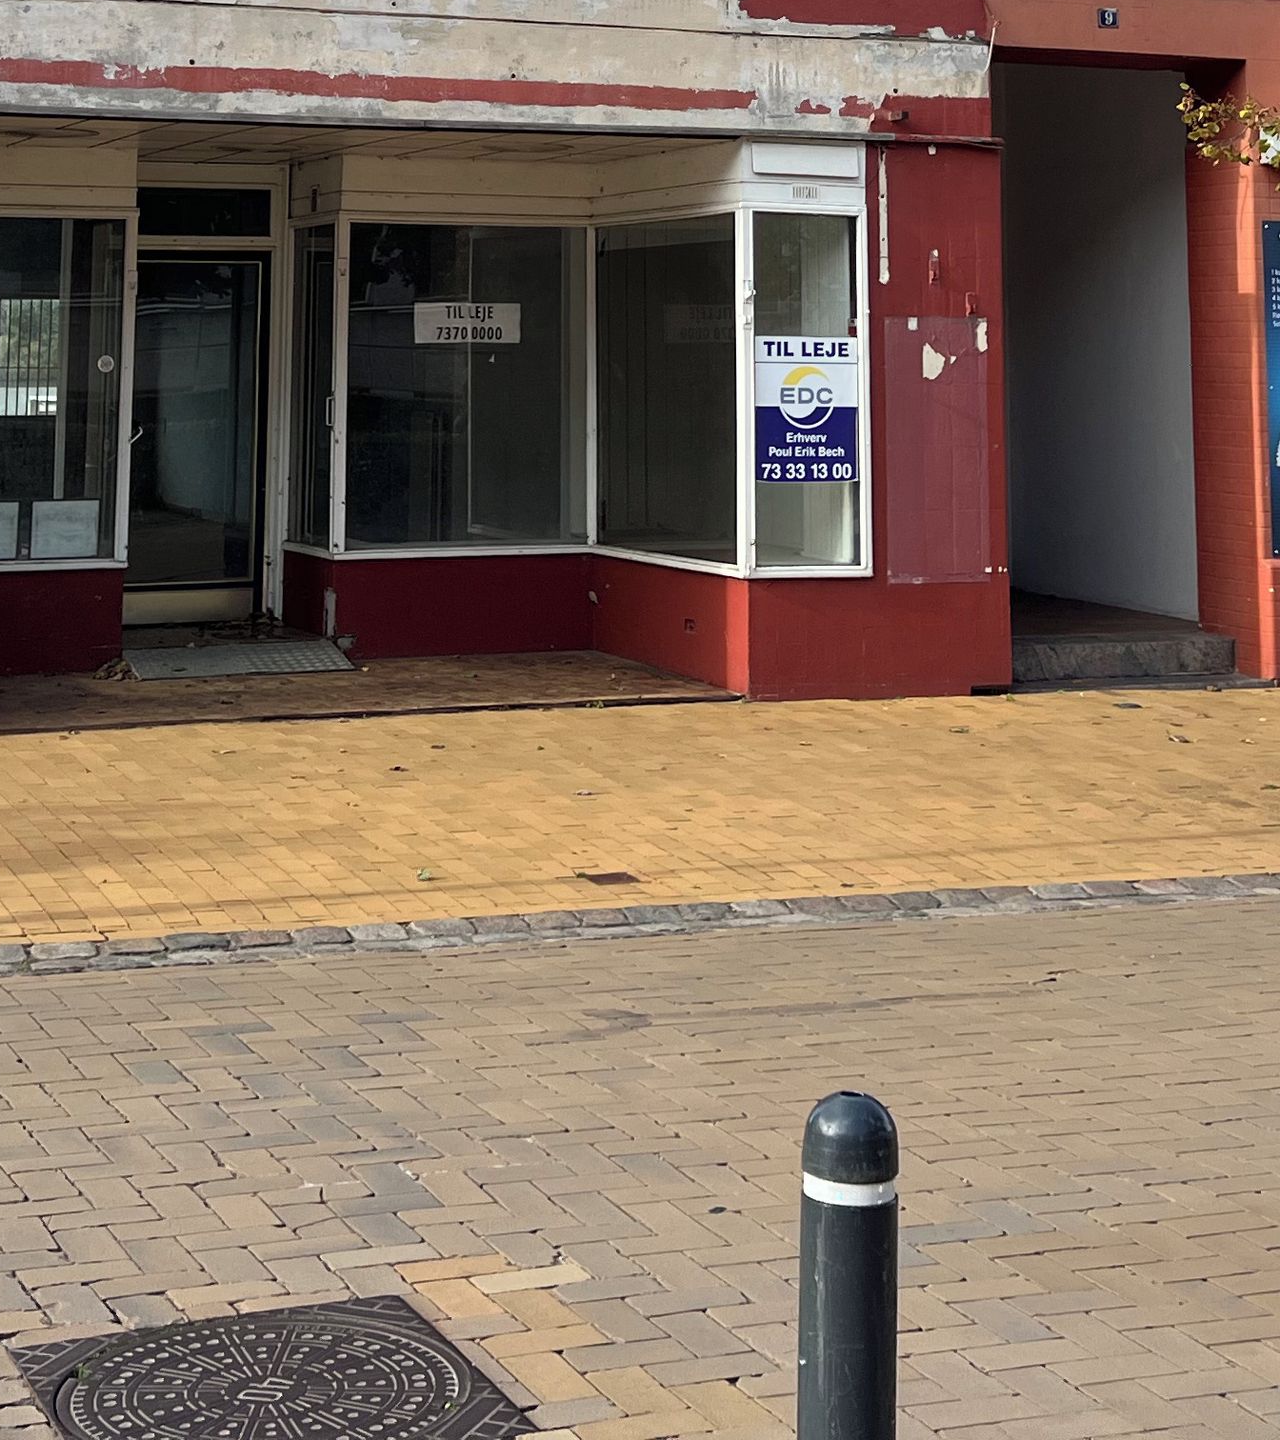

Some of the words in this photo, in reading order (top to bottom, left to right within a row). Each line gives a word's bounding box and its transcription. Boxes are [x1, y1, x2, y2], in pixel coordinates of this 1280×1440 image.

[1104, 10, 1113, 25] 9
[445, 305, 465, 319] TIL
[468, 306, 494, 322] LEJE
[436, 326, 468, 340] 7370
[471, 326, 502, 340] 0000
[763, 341, 794, 357] TIL
[801, 341, 850, 357] LEJE
[780, 387, 833, 405] EDC
[785, 432, 827, 444] Erhverv
[768, 446, 792, 457] Poul
[794, 446, 816, 457] Erik
[818, 446, 845, 457] Bech
[761, 463, 781, 479] 73
[785, 463, 805, 479] 33
[810, 463, 828, 479] 13
[832, 463, 852, 479] 00
